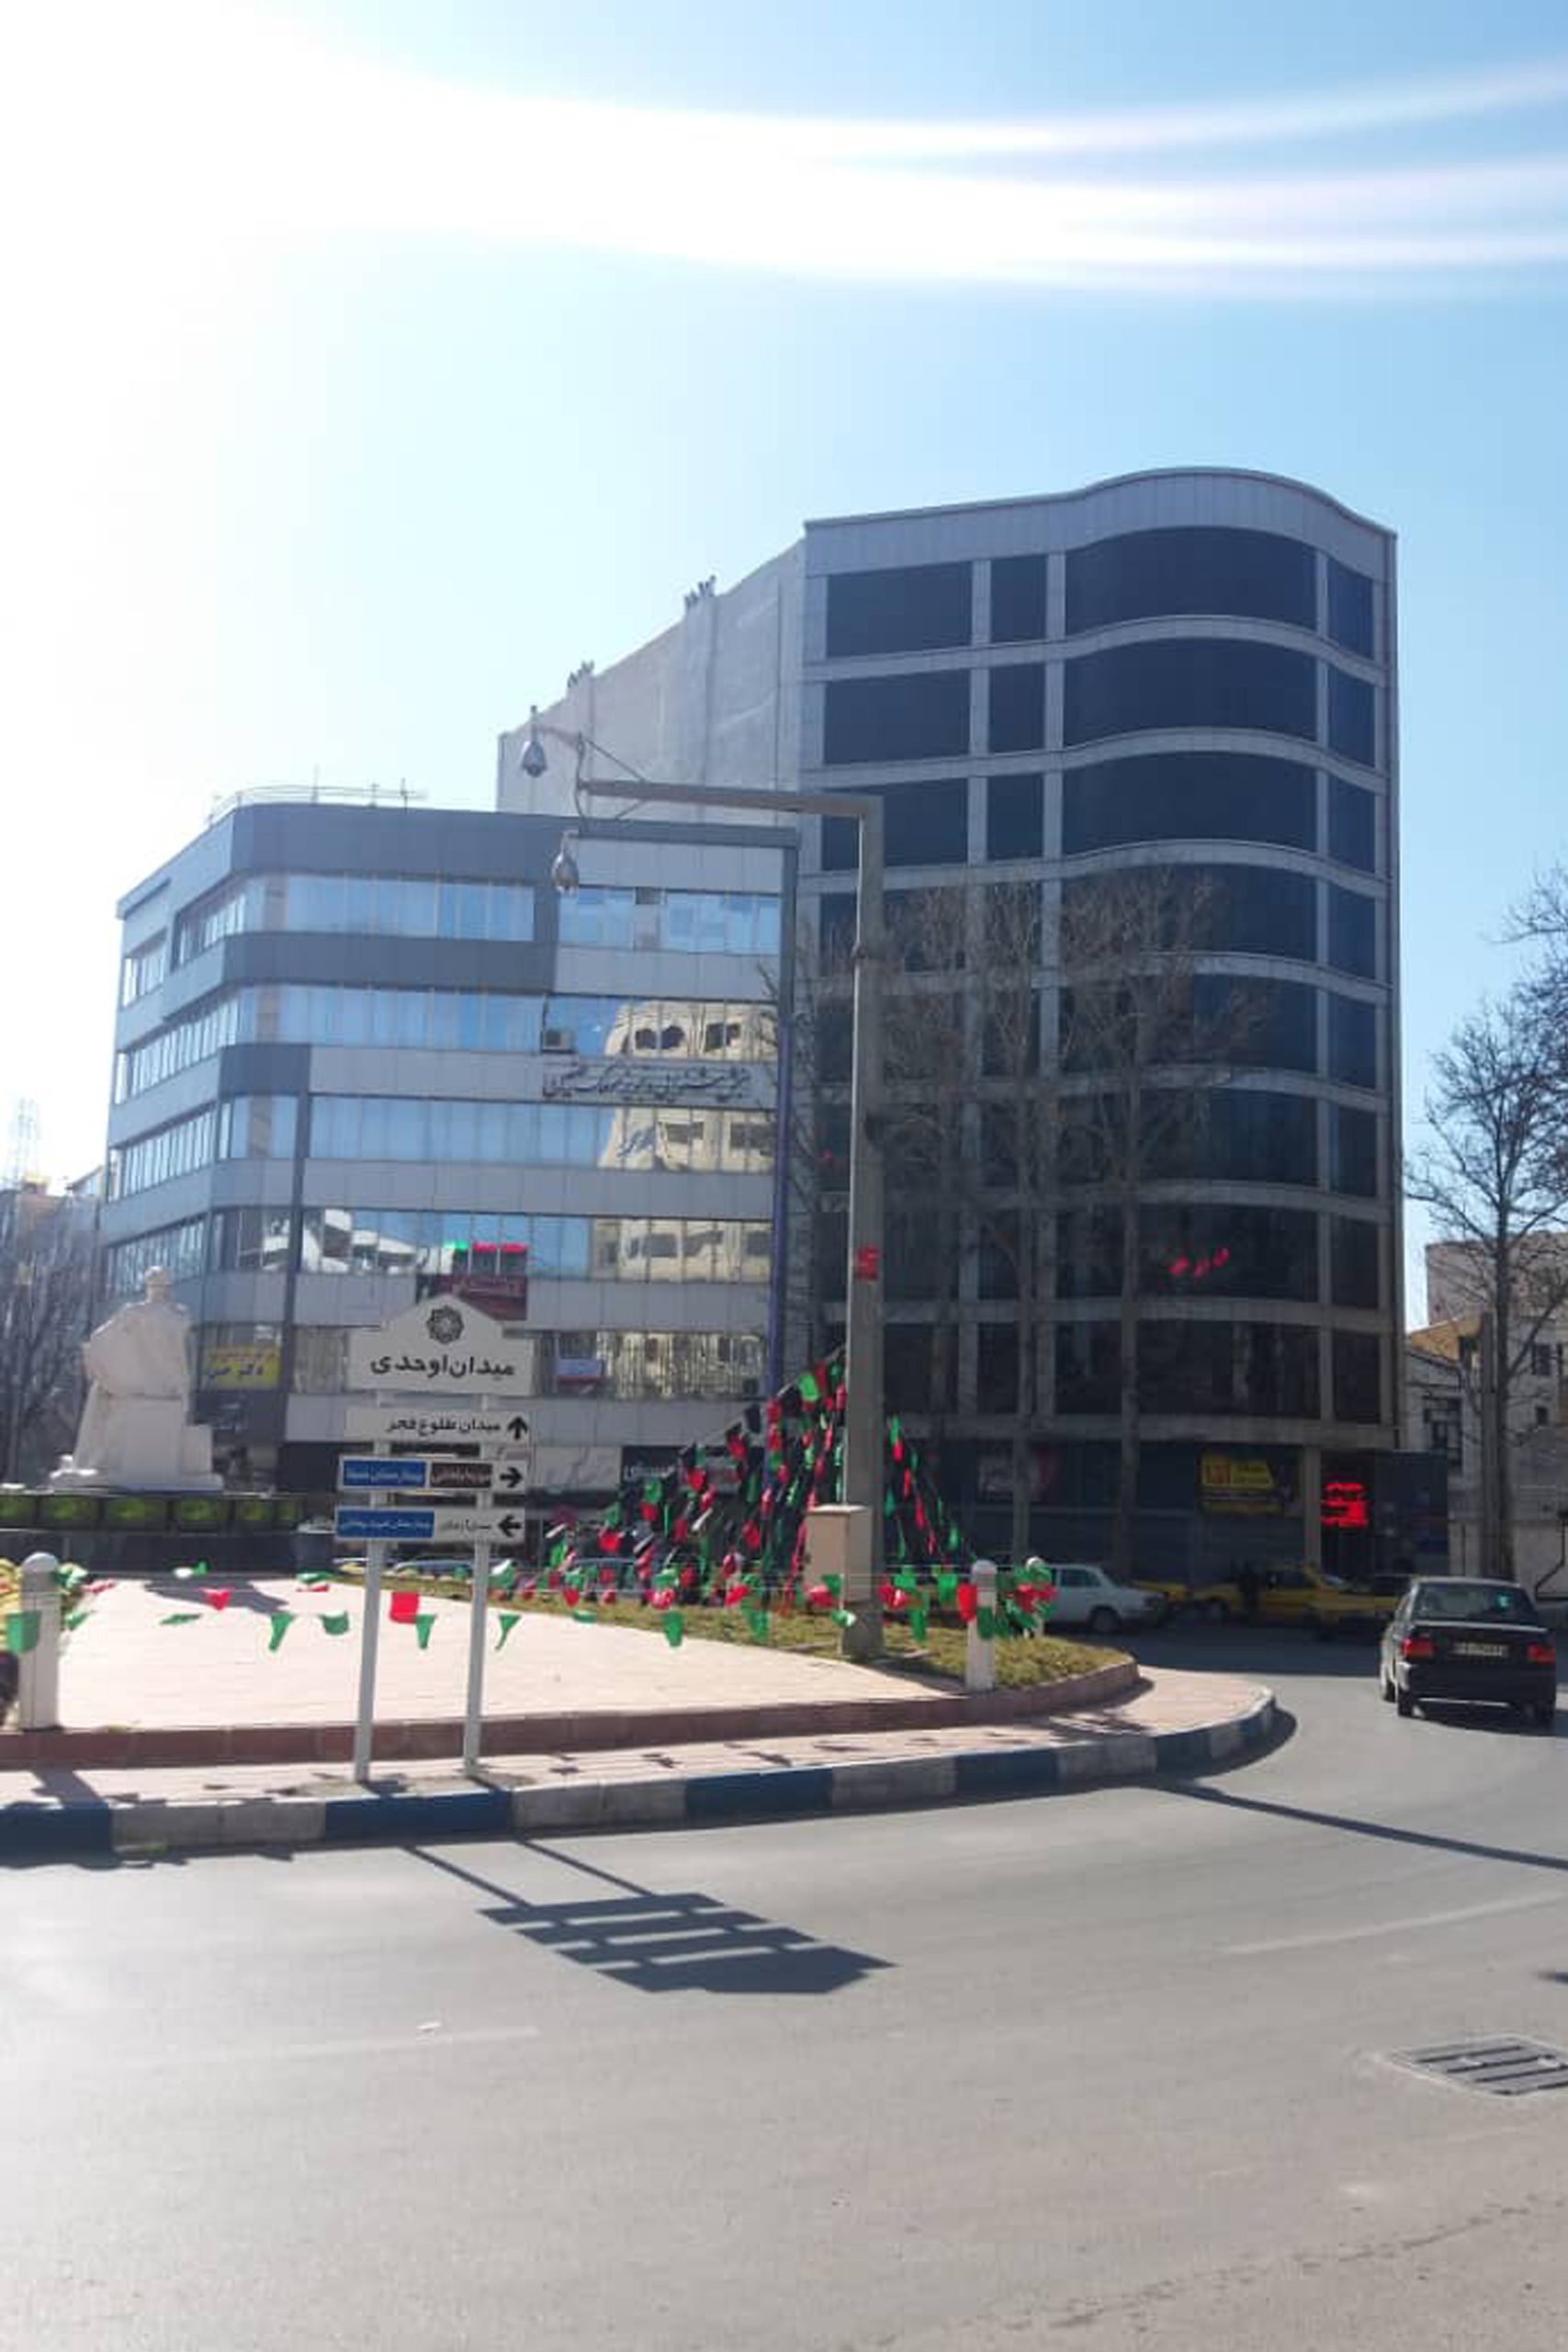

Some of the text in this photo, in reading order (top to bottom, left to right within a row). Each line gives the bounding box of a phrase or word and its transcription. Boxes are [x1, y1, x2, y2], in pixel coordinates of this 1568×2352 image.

[370, 1353, 515, 1380] میدان اوحدی
[459, 1418, 501, 1434] میدان
